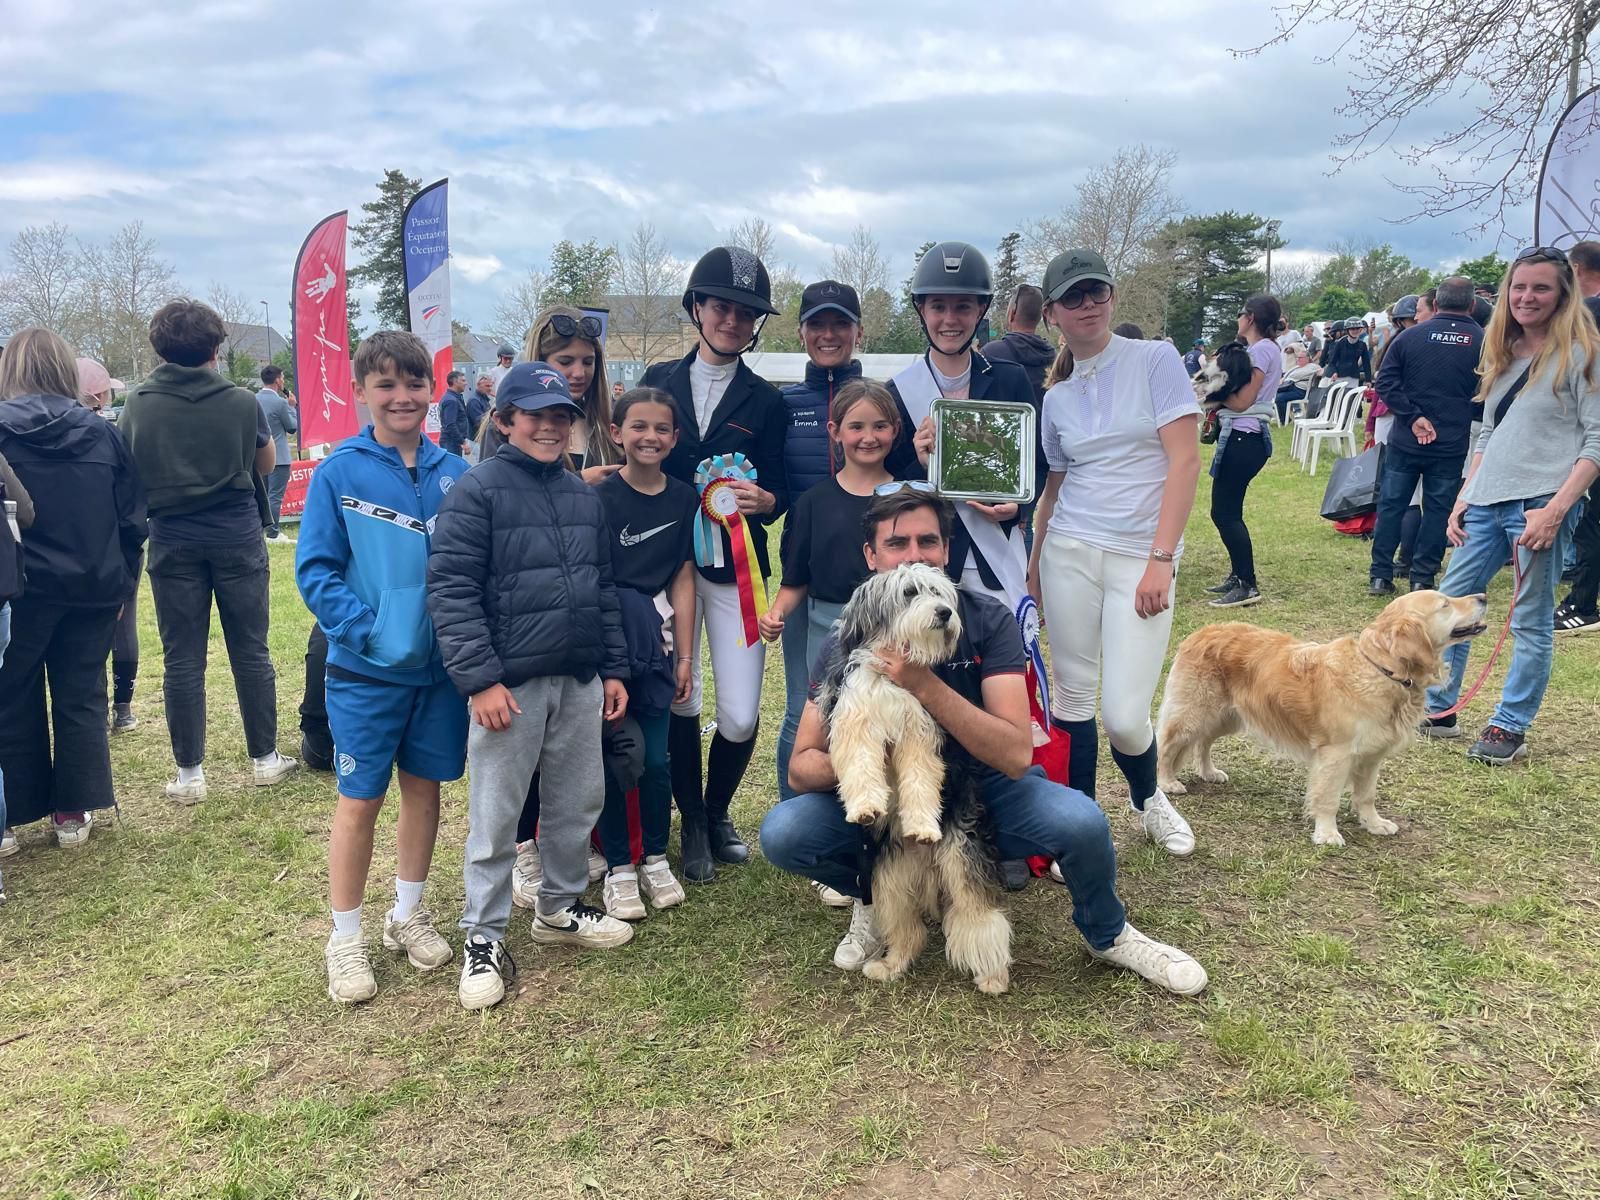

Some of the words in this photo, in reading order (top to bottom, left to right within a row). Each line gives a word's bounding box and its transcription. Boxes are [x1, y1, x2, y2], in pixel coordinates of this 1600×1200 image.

[1430, 333, 1470, 344] FRANCE
[313, 308, 347, 422] equipe
[794, 419, 818, 427] Emma
